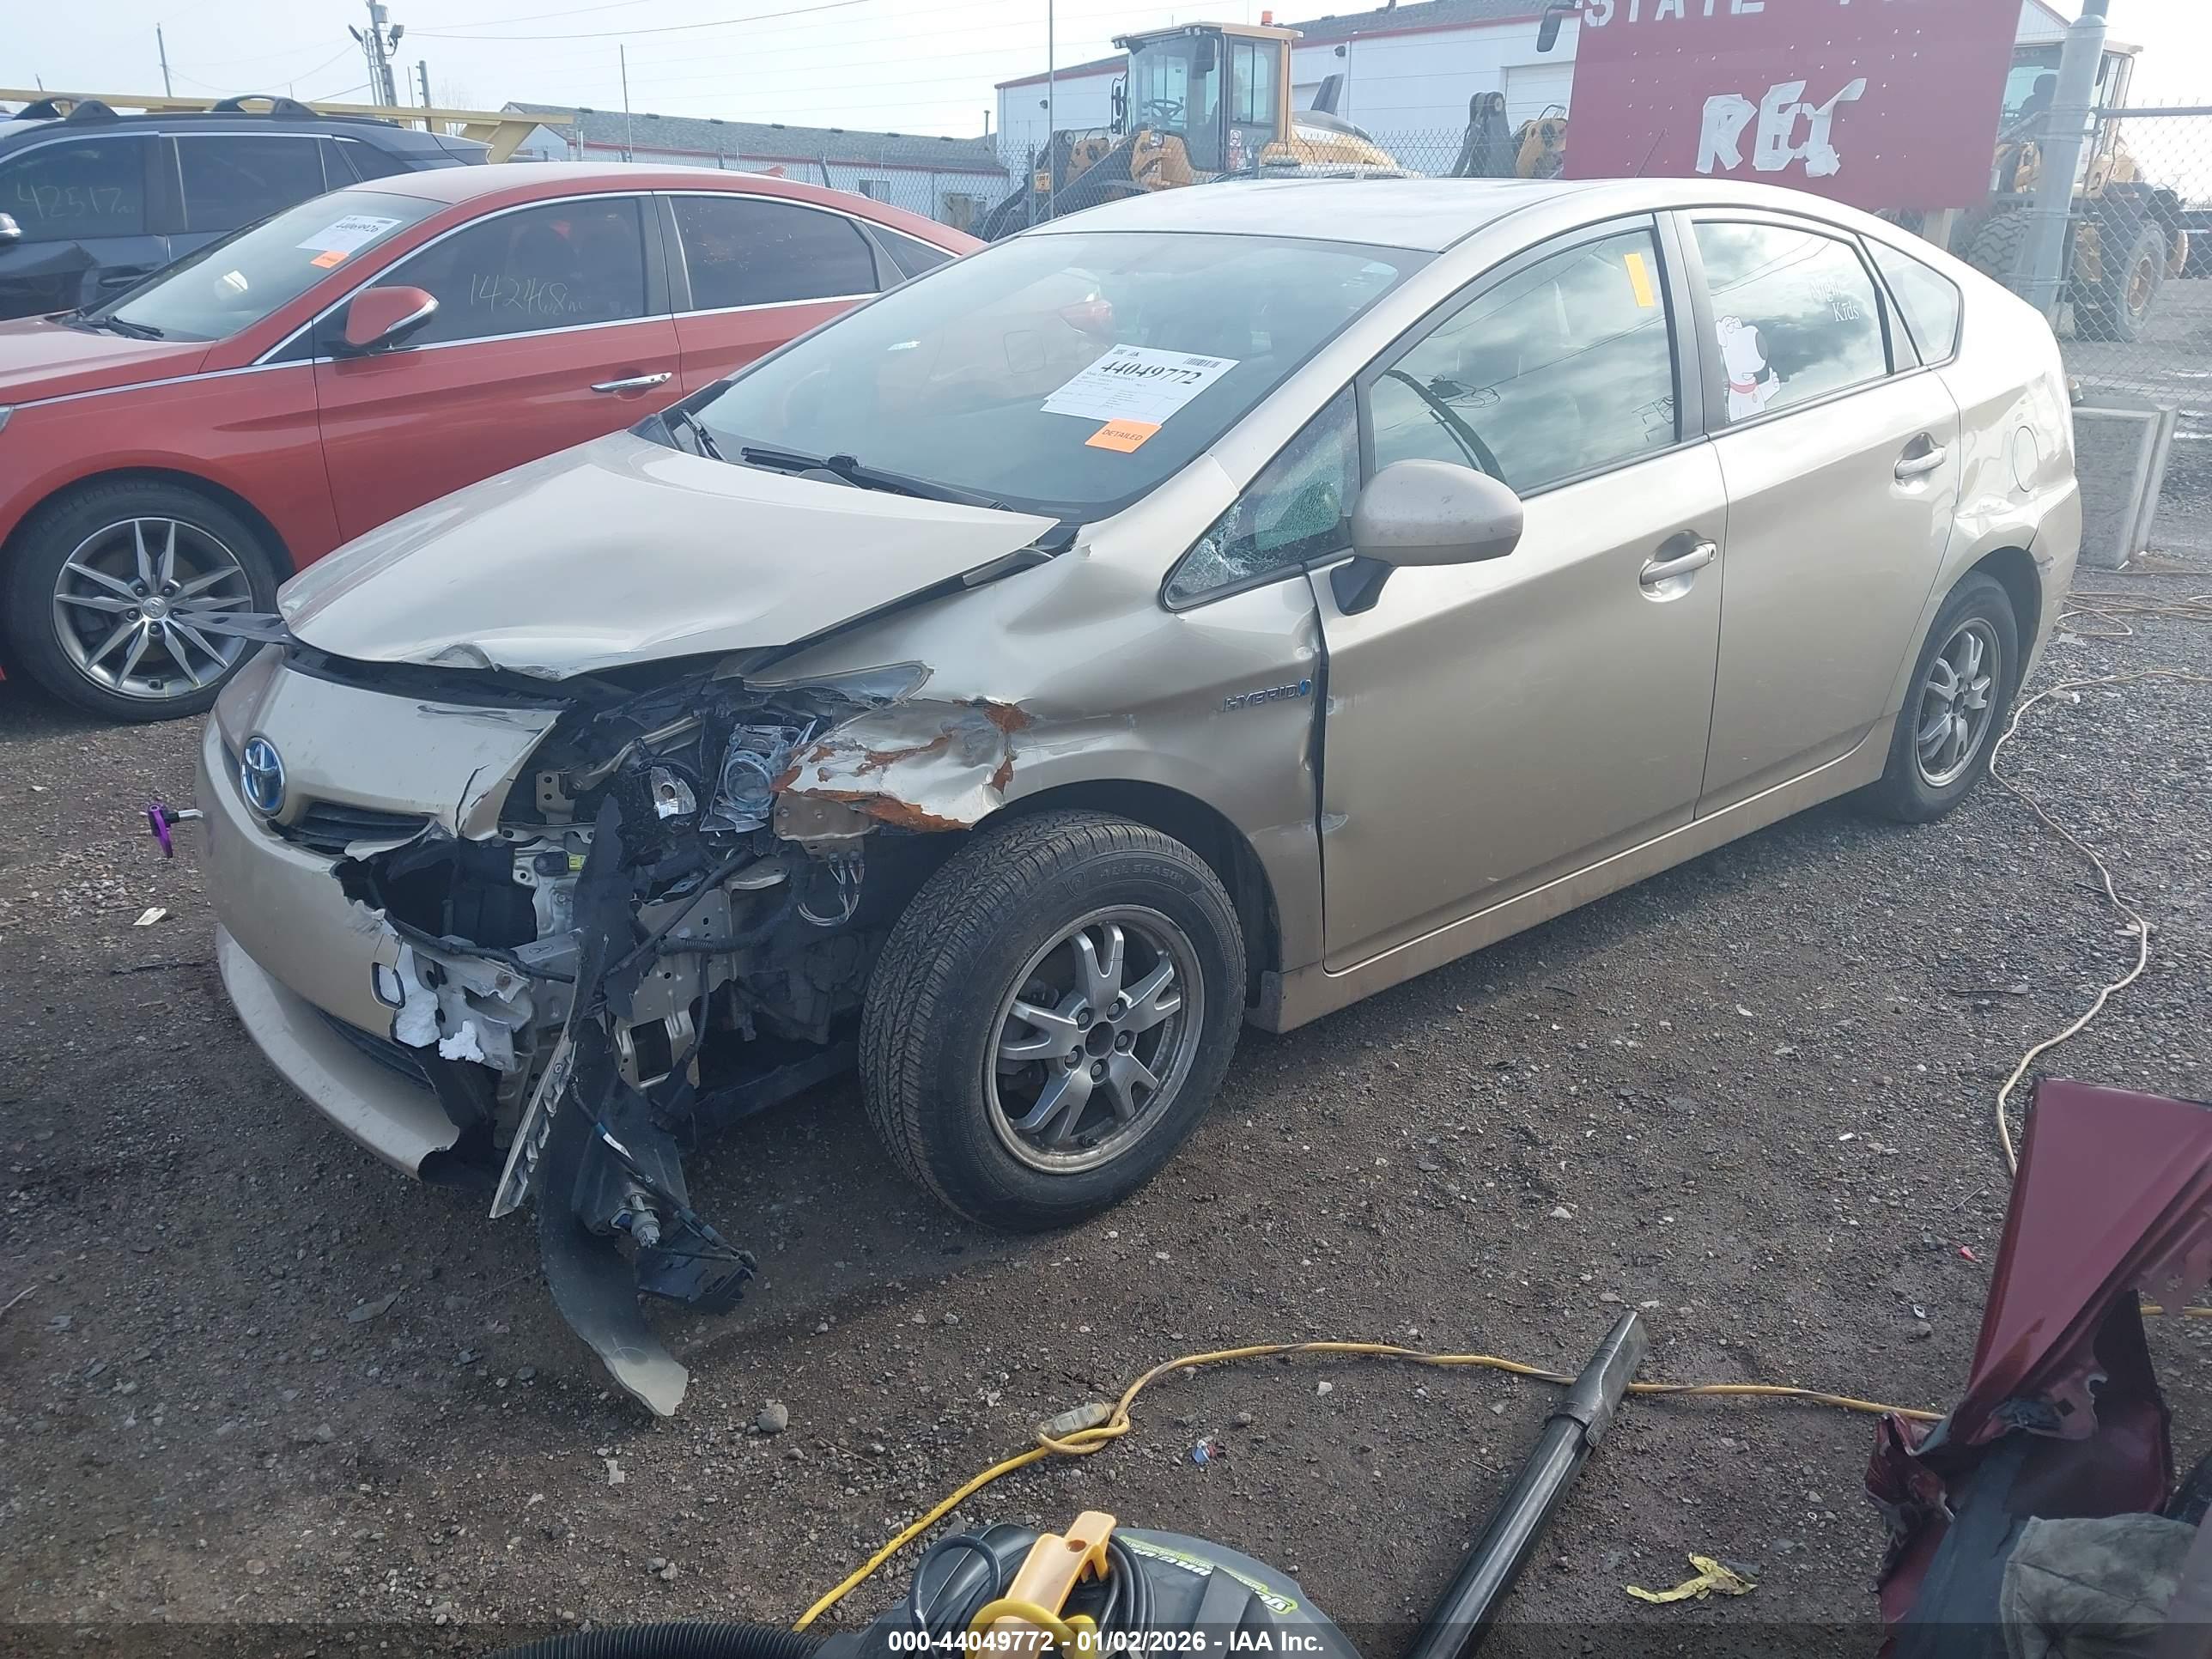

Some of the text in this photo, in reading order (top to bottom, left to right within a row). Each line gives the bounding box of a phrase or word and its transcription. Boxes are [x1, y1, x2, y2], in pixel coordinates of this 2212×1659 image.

[1101, 361, 1202, 385] 44049772
[1102, 428, 1143, 442] DETAILED
[1223, 684, 1297, 712] HYBRID
[1133, 864, 1188, 886] SEASON
